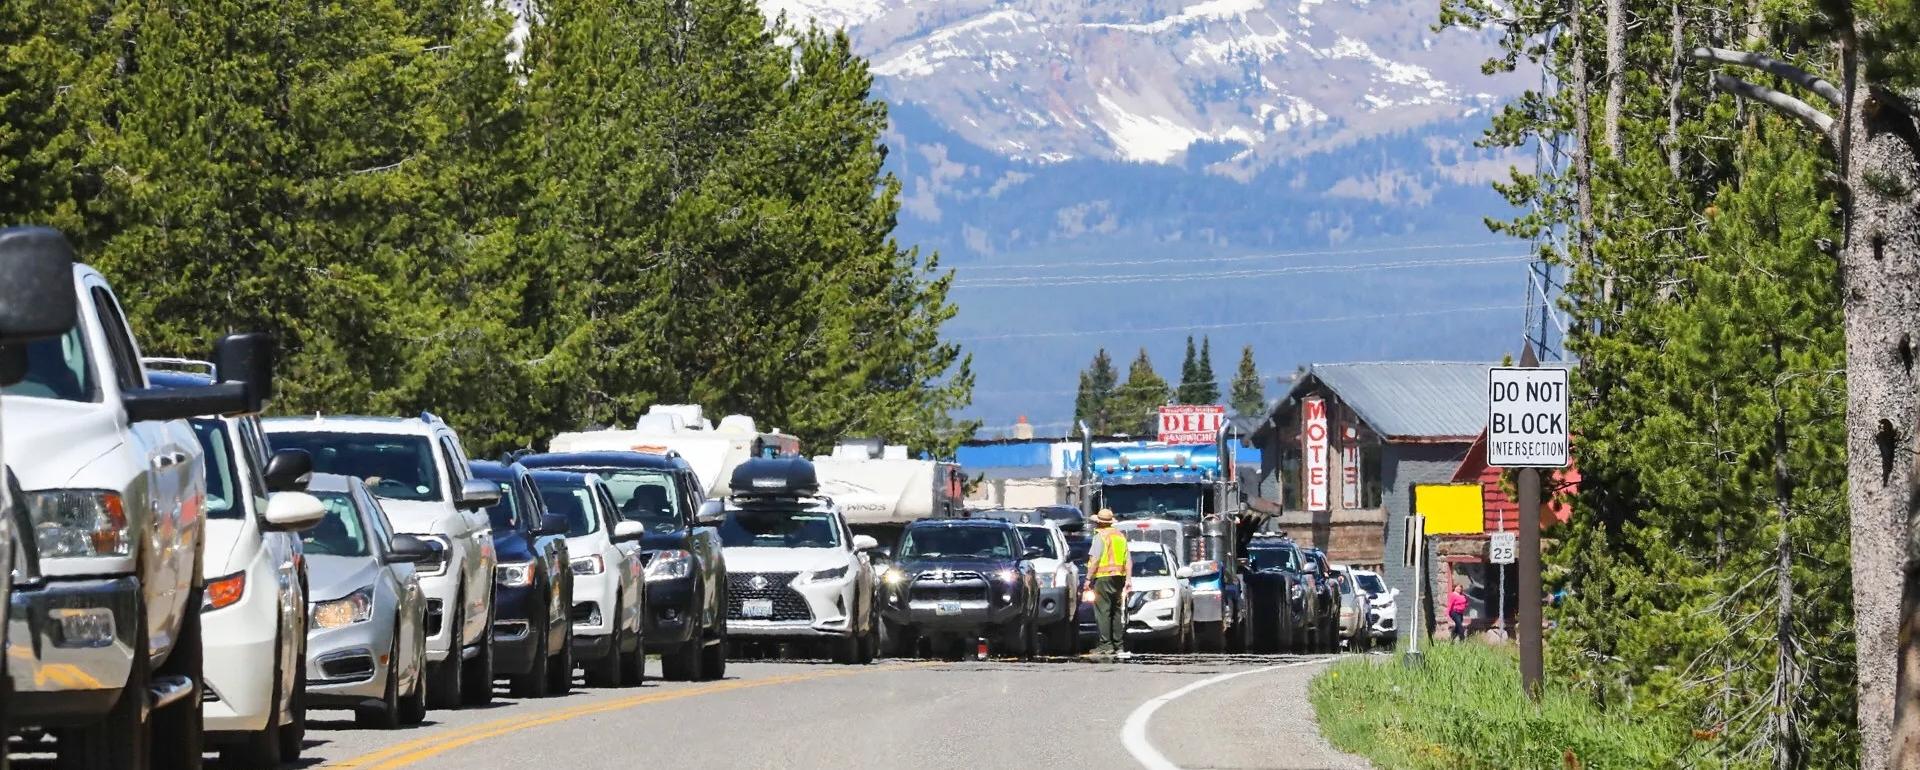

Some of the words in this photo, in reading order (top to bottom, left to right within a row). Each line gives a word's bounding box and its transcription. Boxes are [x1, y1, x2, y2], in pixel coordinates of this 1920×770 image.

[1493, 381, 1519, 402] DO
[1526, 381, 1563, 402] NOT
[1163, 414, 1219, 432] DELI
[1492, 412, 1563, 435] BLOCK
[1305, 401, 1326, 507] MOTEL
[1492, 441, 1564, 457] INTERSECTION
[846, 503, 887, 512] WINDS
[1493, 547, 1513, 560] 25
